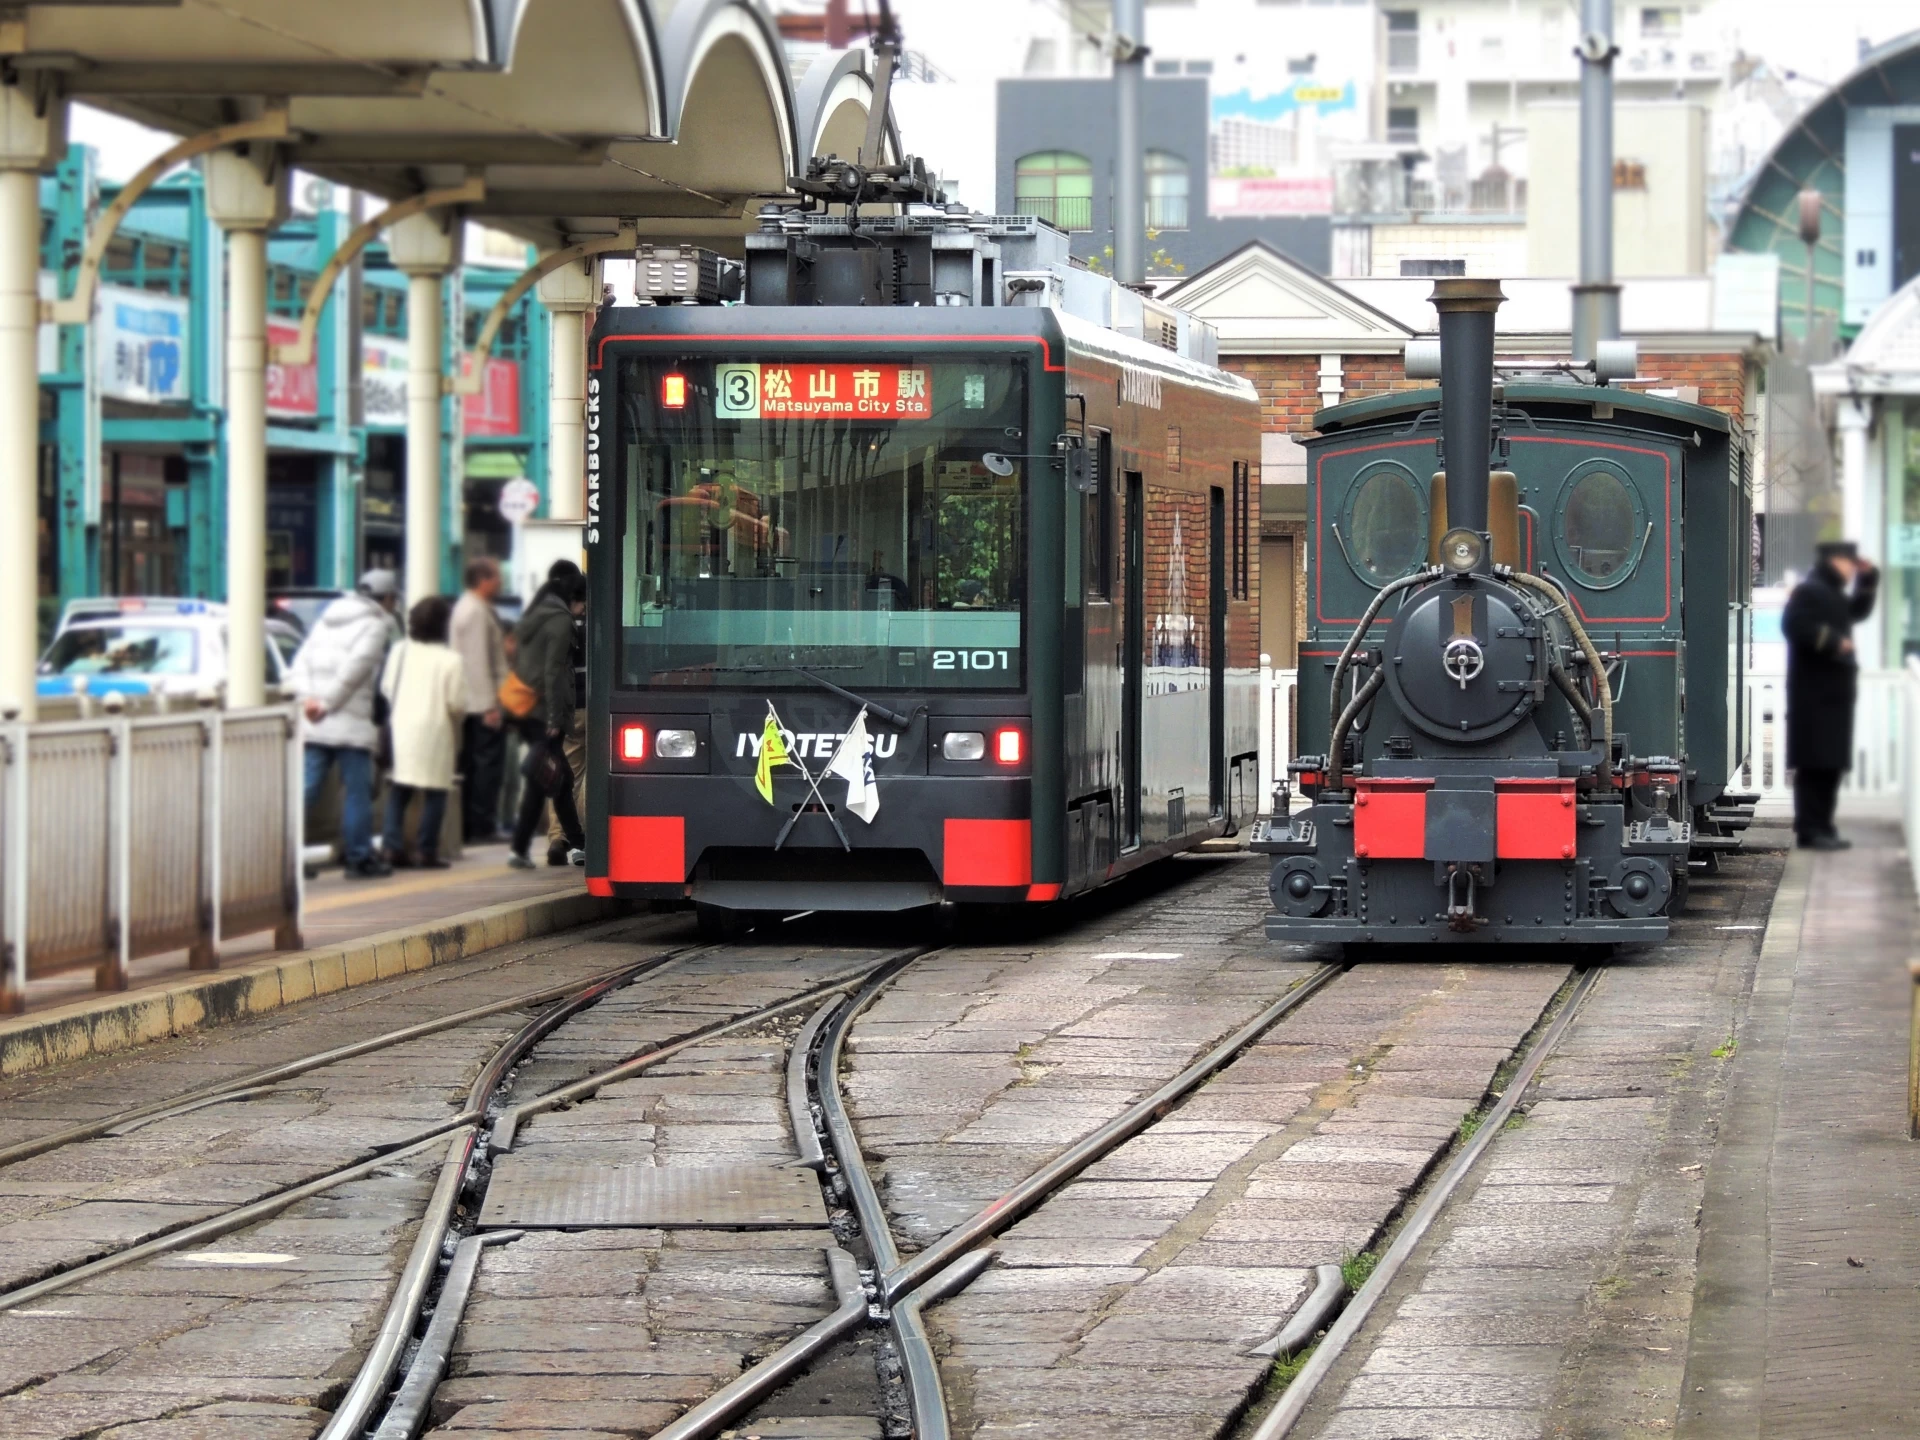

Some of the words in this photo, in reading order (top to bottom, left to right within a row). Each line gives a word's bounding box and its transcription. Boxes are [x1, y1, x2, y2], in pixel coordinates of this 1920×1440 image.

[729, 375, 750, 406] 3
[764, 369, 926, 398] 松山市駅
[764, 400, 853, 413] Matsuyama
[858, 400, 890, 413] City
[895, 400, 928, 412] Sta.
[588, 378, 600, 544] STARBUCKS
[933, 650, 1008, 670] 2101
